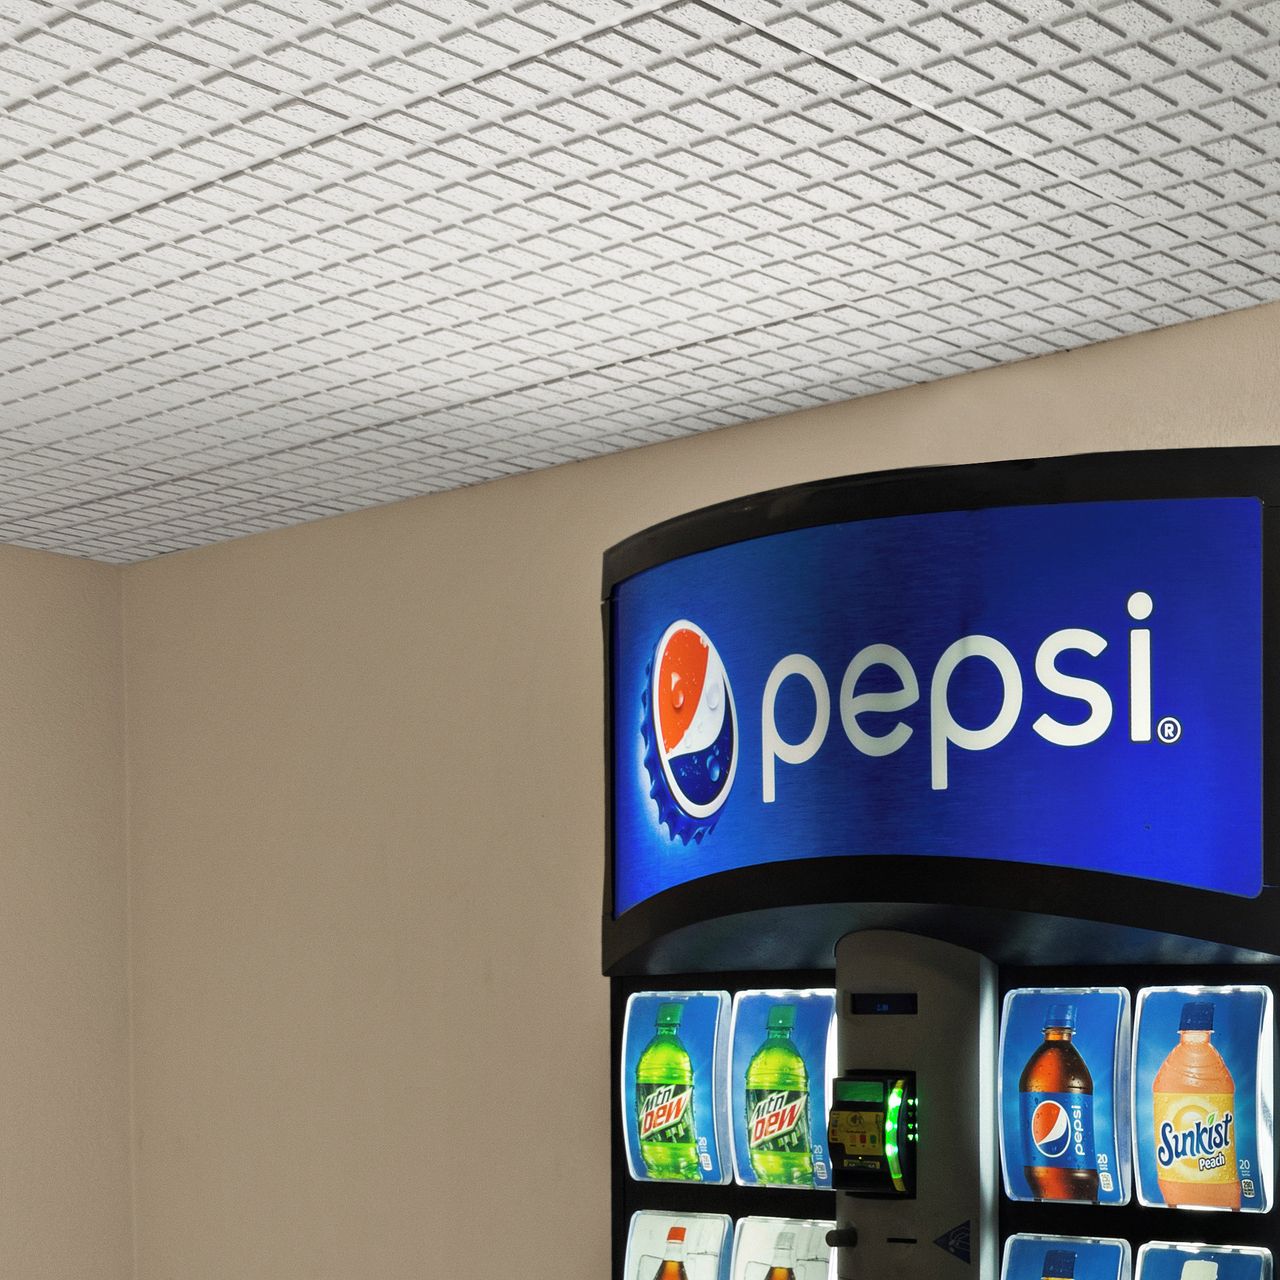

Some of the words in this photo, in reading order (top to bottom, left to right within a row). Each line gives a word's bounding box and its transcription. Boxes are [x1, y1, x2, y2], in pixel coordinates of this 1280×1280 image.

[763, 591, 1152, 803] pepsi
[1072, 1105, 1085, 1156] pepsi
[1158, 1113, 1232, 1167] Sunkist
[1198, 1152, 1225, 1171] Peach
